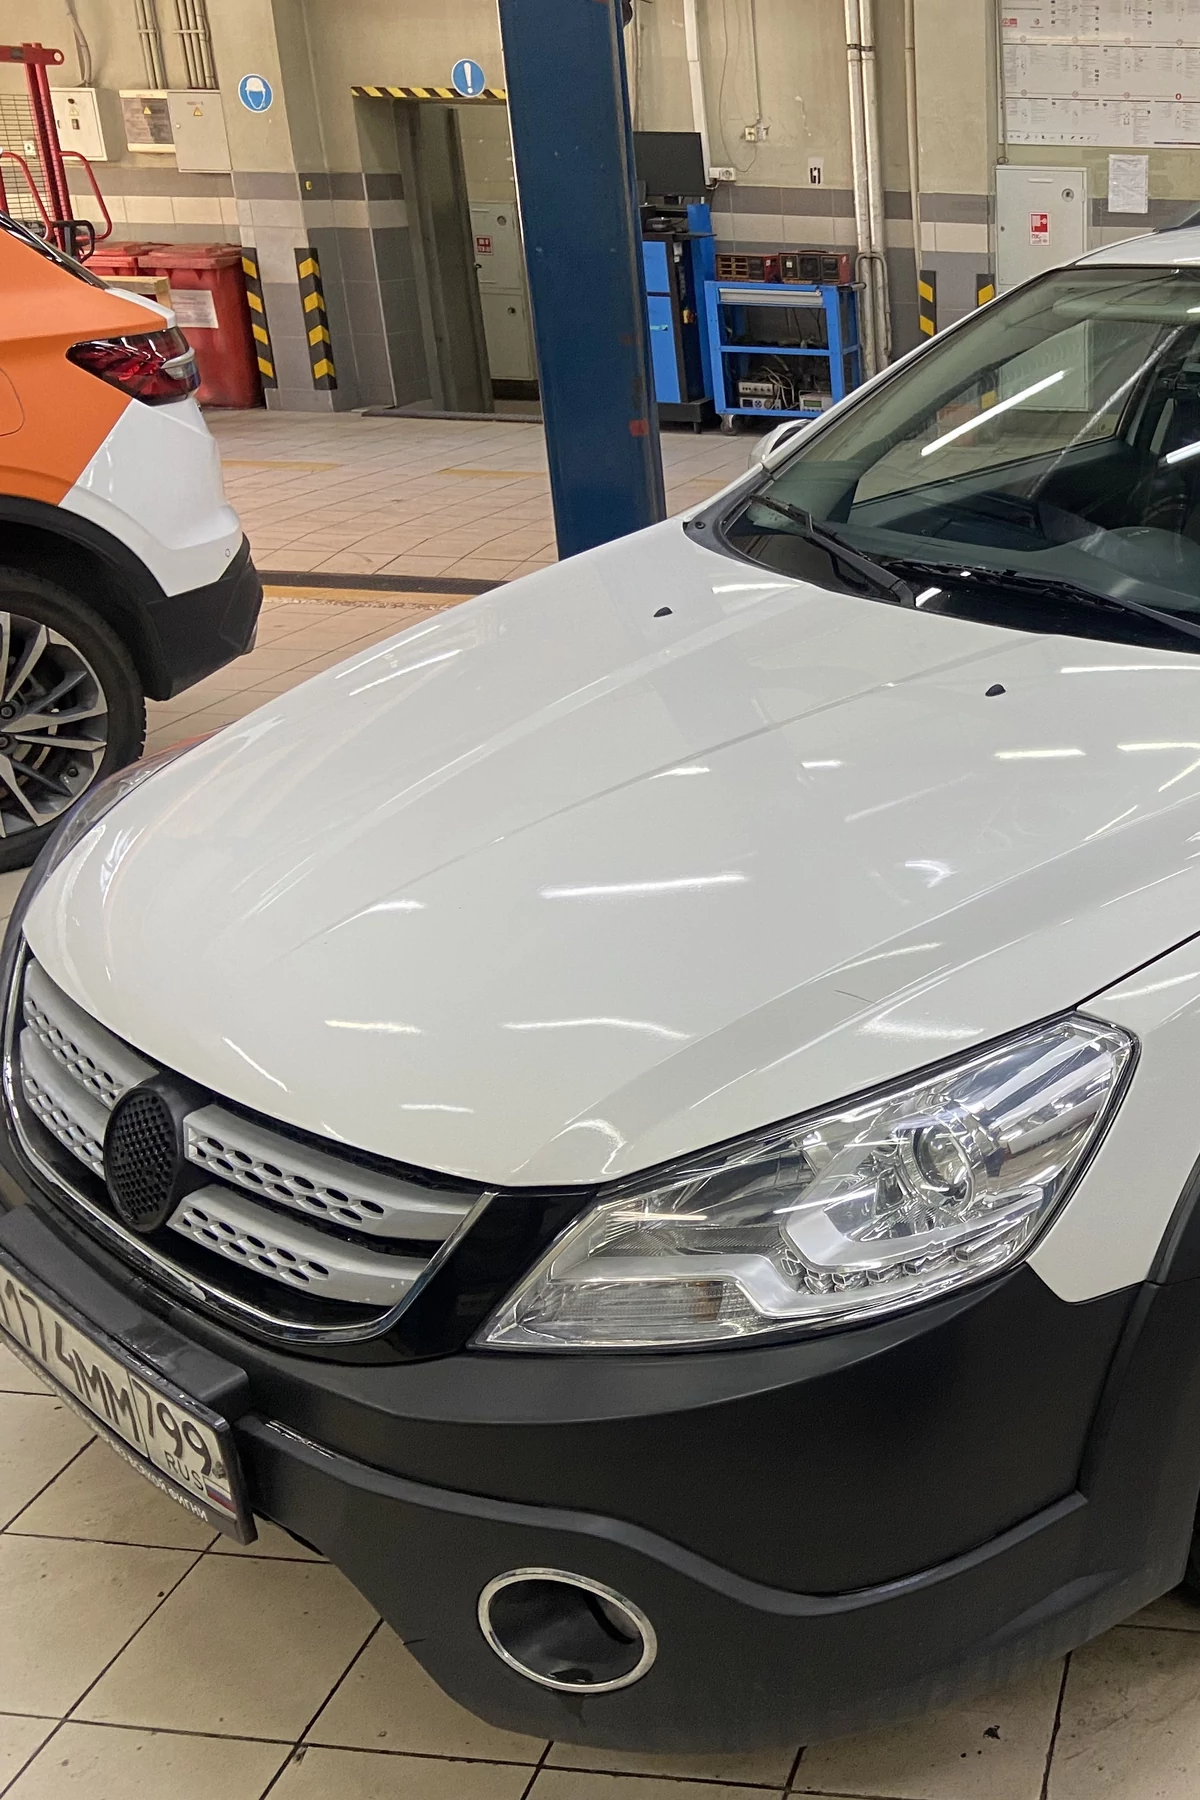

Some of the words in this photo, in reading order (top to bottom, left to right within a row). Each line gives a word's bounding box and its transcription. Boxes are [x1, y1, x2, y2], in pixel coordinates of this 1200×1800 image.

[0, 1279, 139, 1443] 174MM
[132, 1378, 212, 1476] 799
[164, 1450, 204, 1491] RUS
